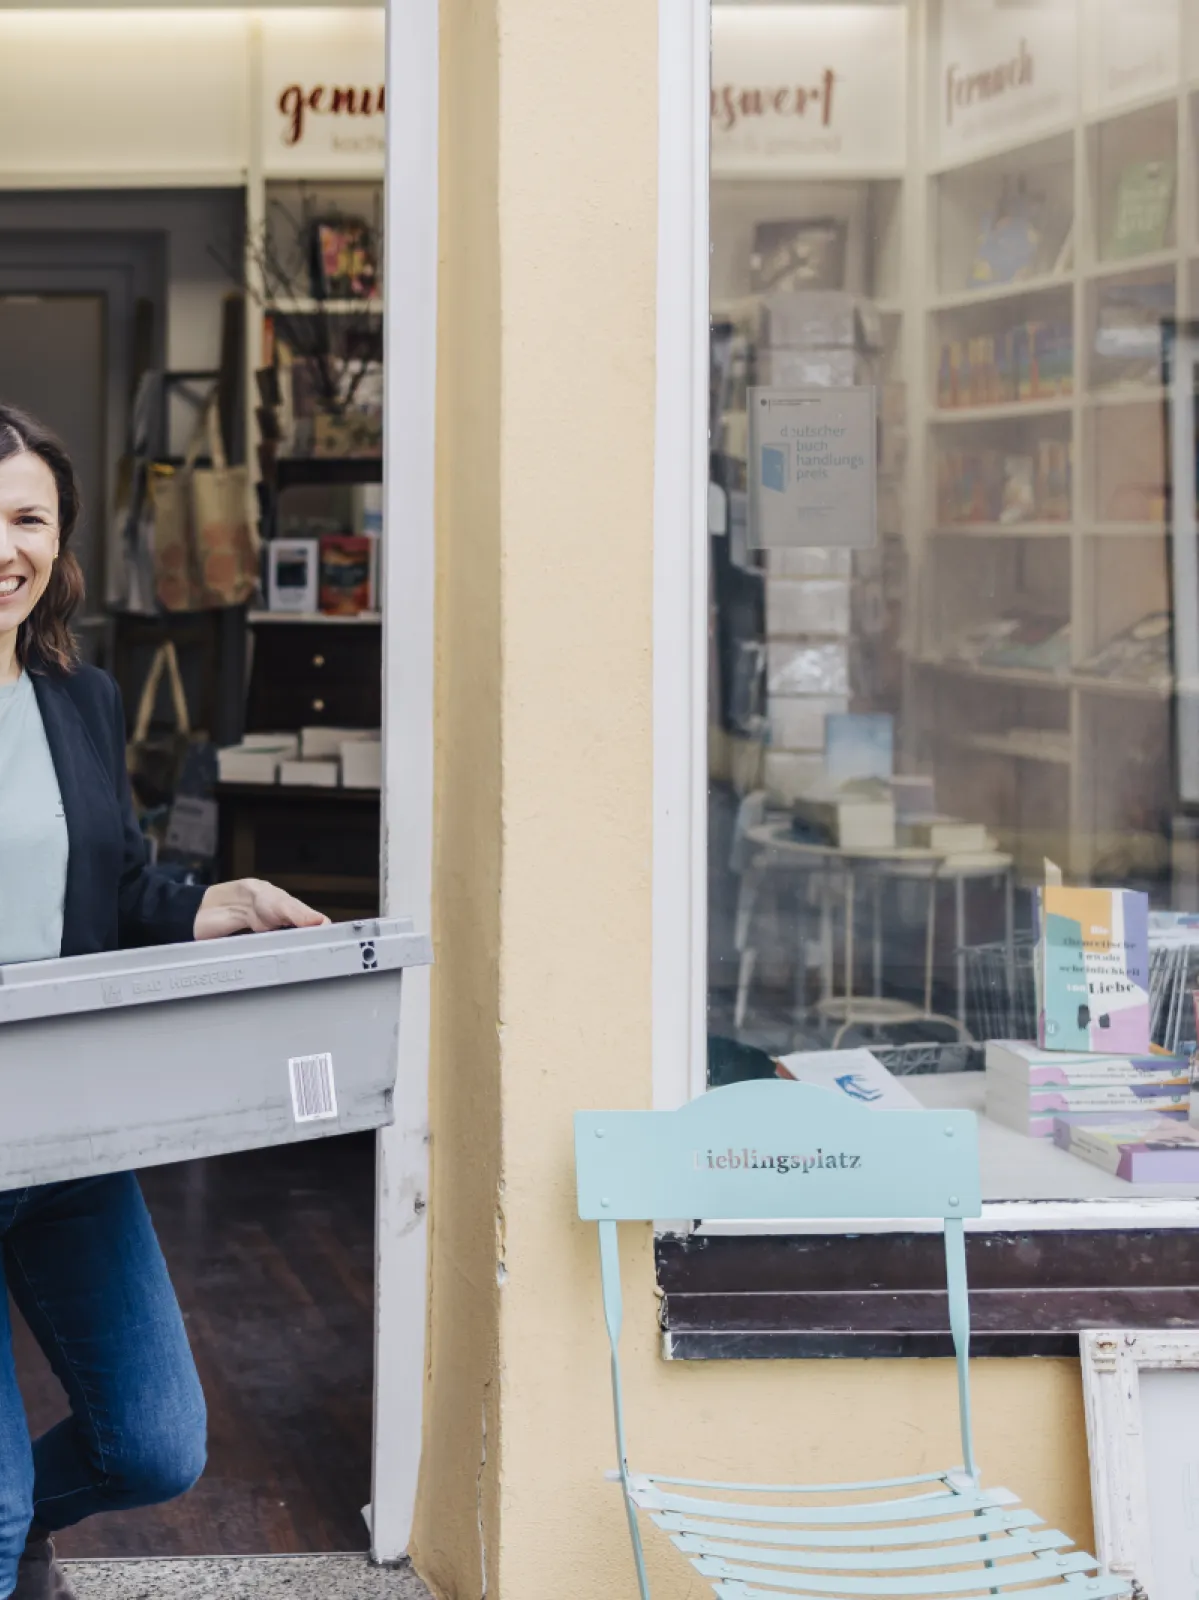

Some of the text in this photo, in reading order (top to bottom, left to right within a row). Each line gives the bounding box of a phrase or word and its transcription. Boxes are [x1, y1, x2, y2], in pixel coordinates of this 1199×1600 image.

[711, 66, 844, 131] swert
[278, 83, 385, 148] genu
[796, 440, 829, 453] buch
[796, 453, 865, 470] handlungs
[796, 468, 829, 482] preis
[1088, 980, 1136, 994] Liebe
[692, 1148, 862, 1174] Lieblingsplatz
